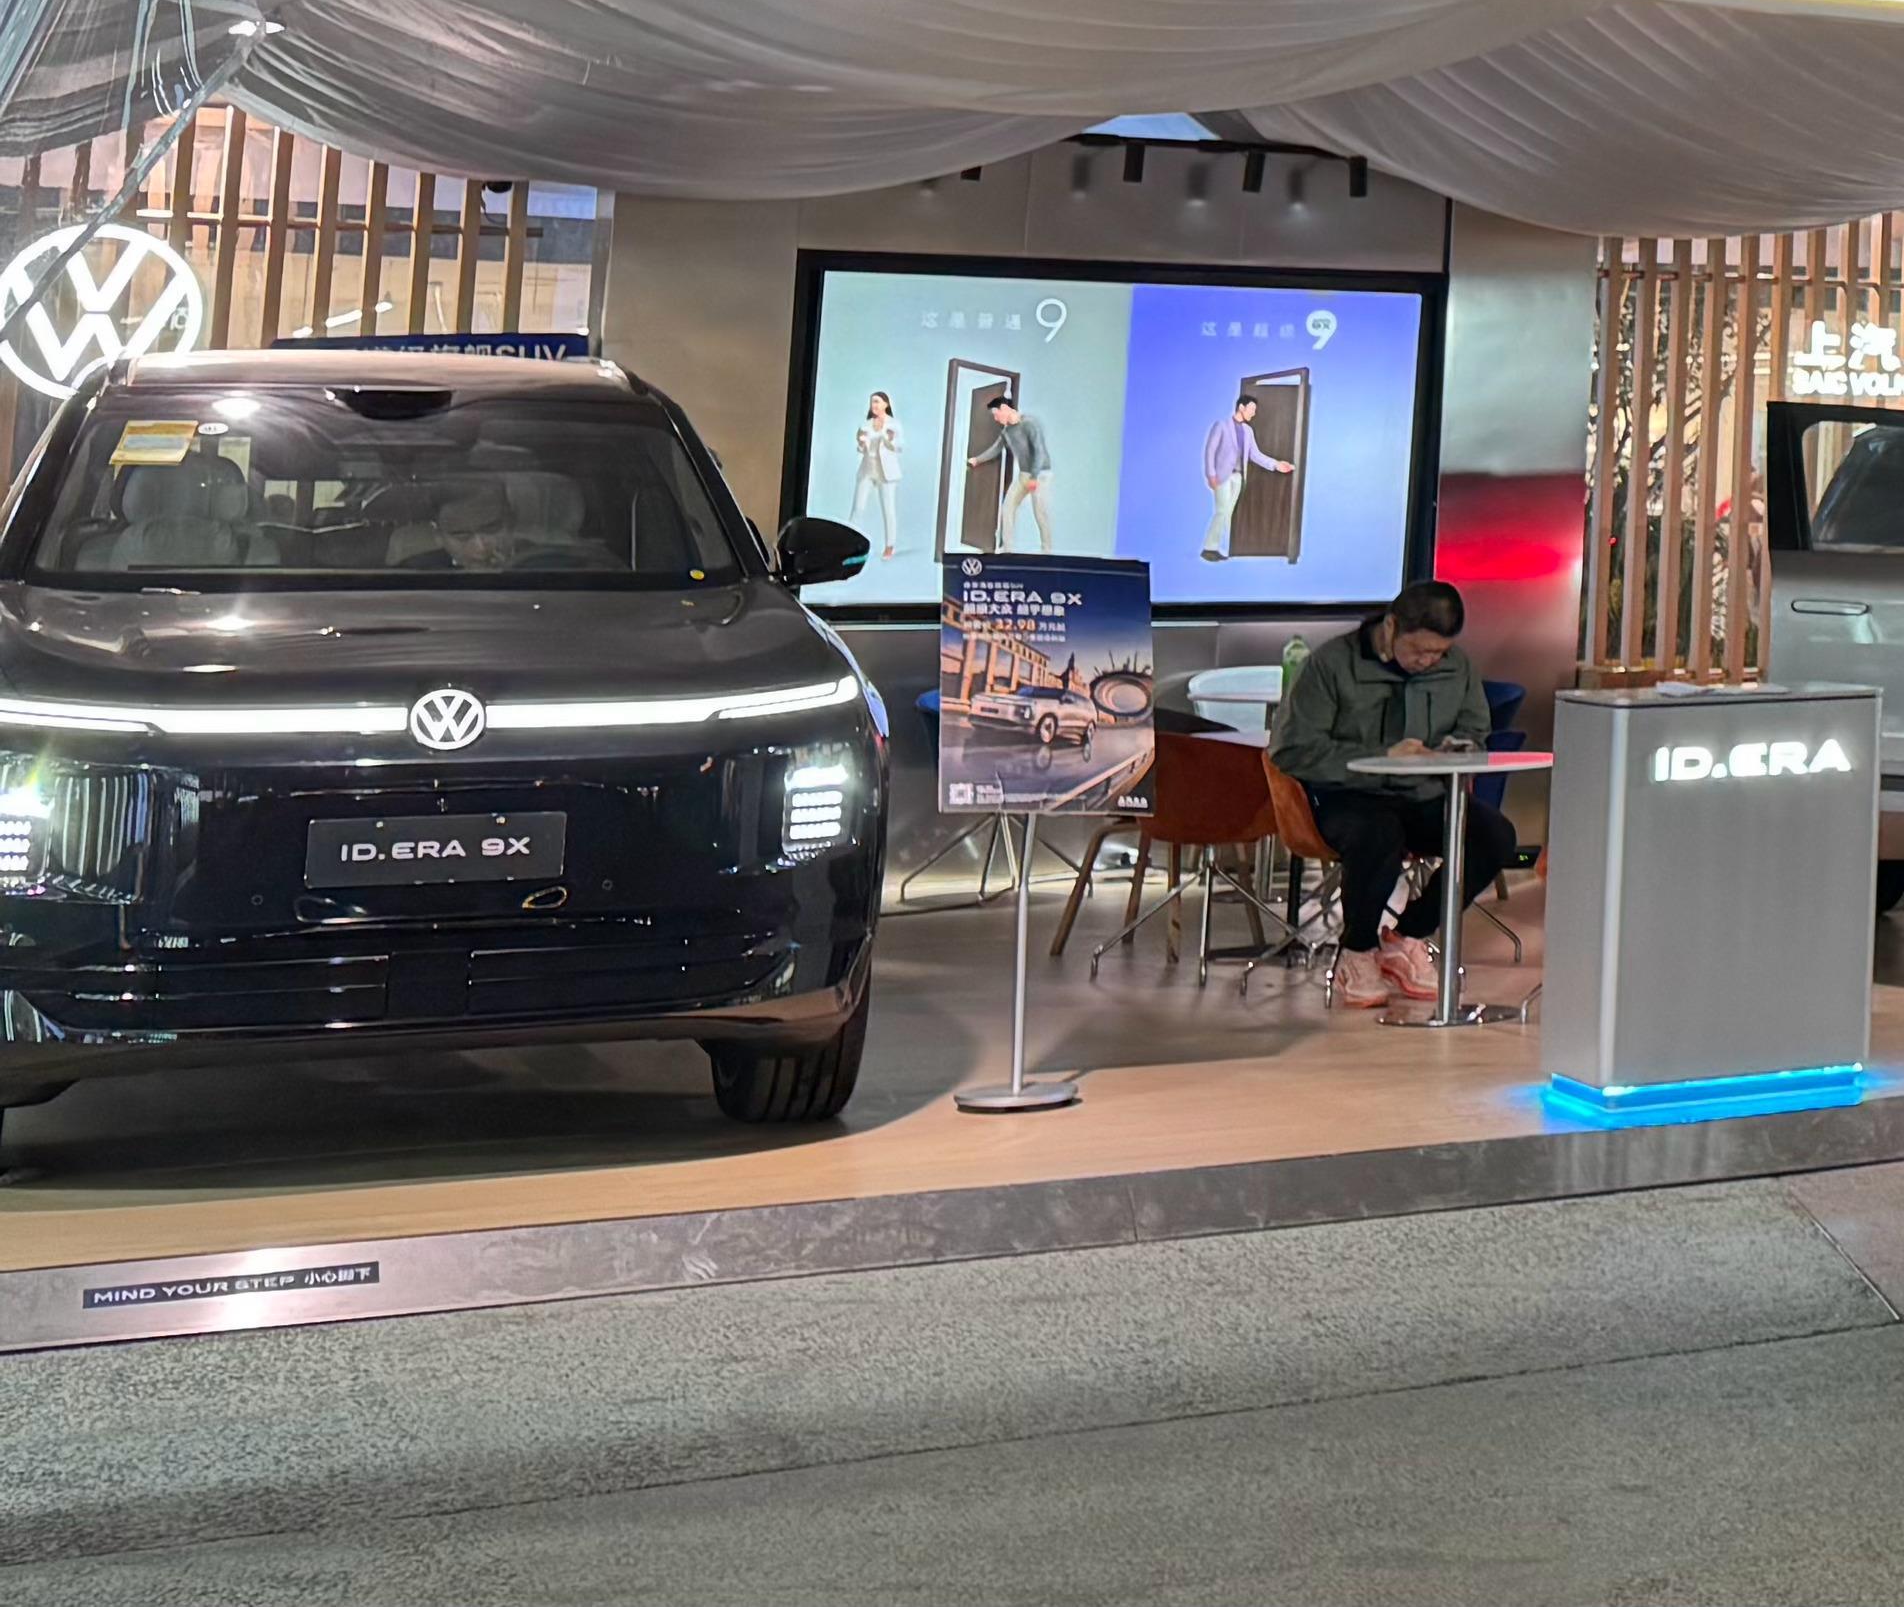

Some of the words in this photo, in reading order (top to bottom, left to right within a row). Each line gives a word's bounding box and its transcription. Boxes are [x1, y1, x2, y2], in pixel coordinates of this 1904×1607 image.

[1035, 298, 1068, 344] 9
[1652, 737, 1851, 784] ID.ERA
[340, 839, 467, 862] ID.ERA
[481, 837, 531, 857] 9X
[93, 1288, 156, 1304] MIND
[162, 1281, 229, 1297] YOUR
[235, 1275, 295, 1291] STEP
